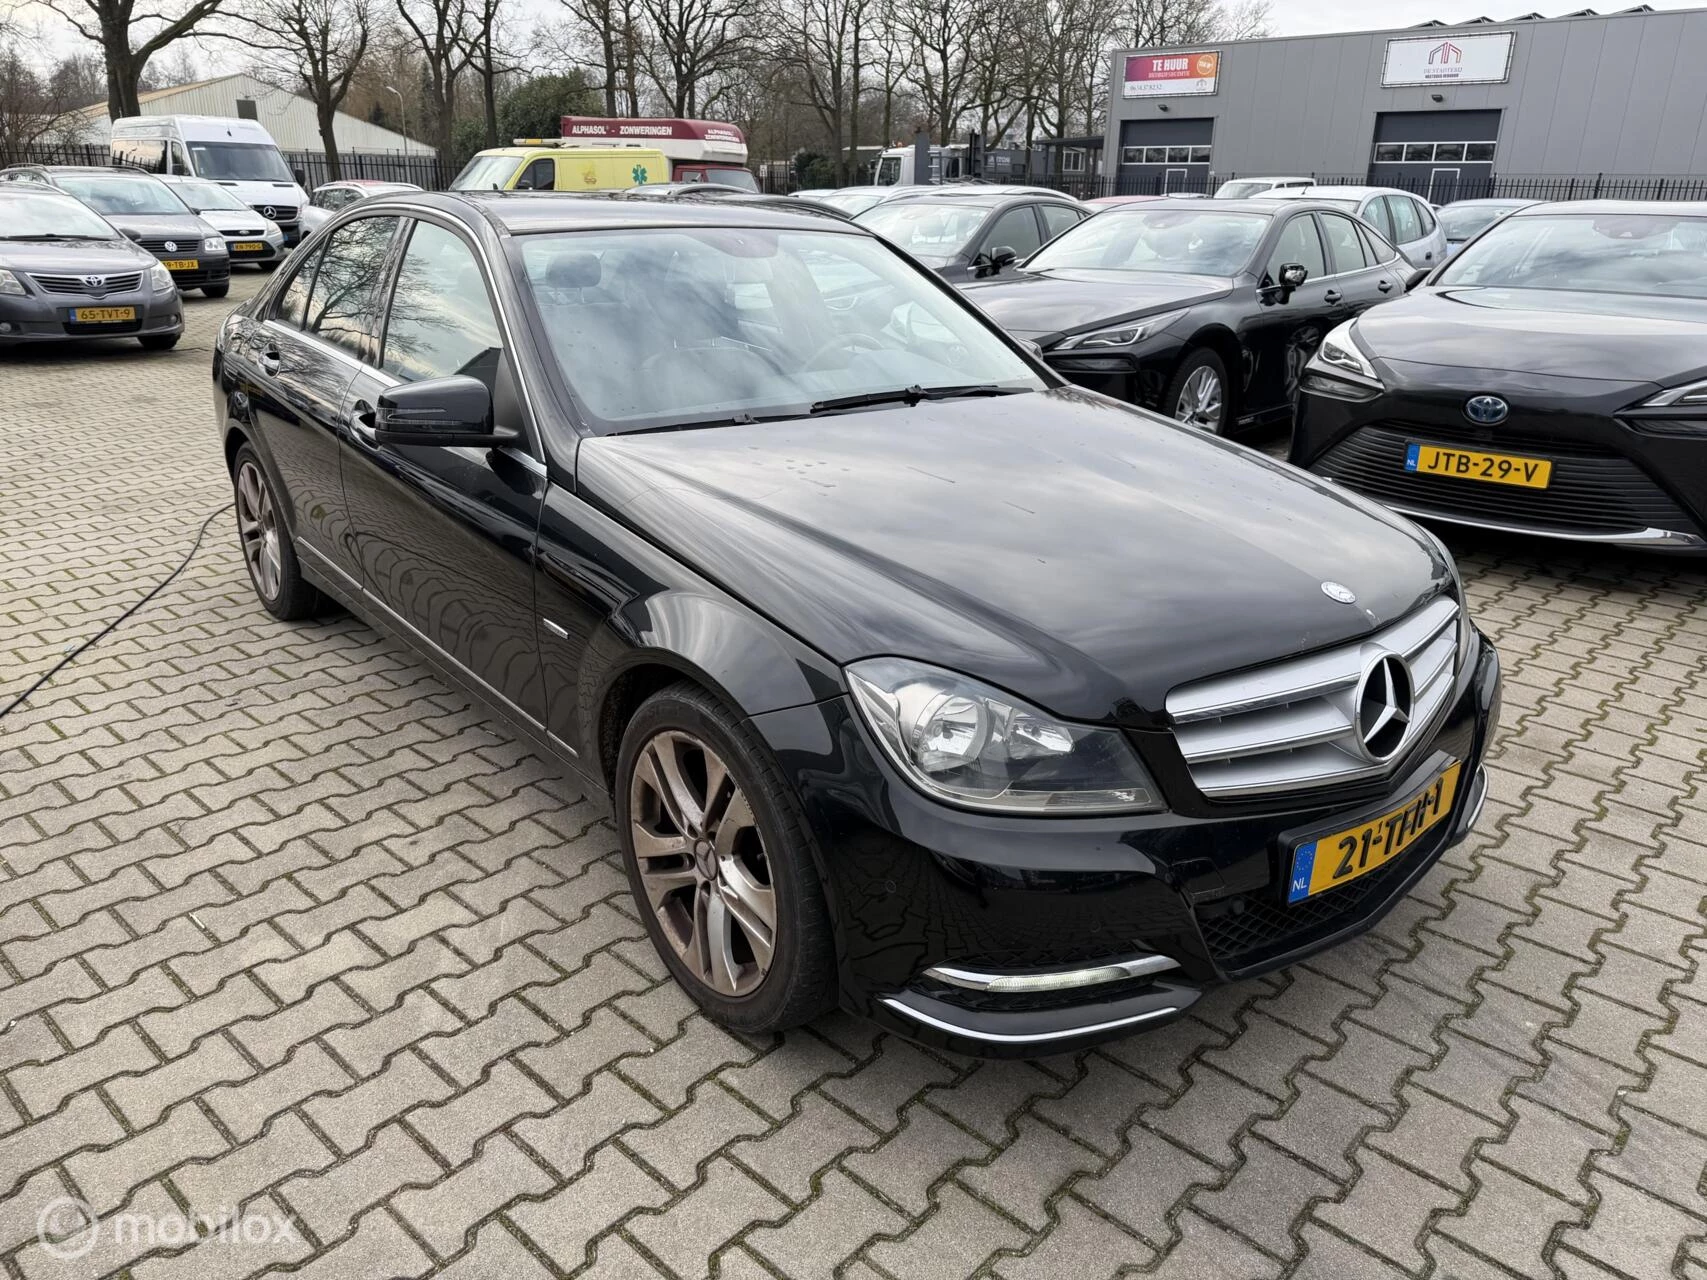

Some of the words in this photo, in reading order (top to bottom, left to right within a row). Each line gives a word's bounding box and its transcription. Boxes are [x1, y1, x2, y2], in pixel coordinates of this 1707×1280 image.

[1152, 60, 1163, 72] TE
[1164, 58, 1188, 71] HUUR
[619, 126, 672, 135] ZONWERINGEN
[80, 308, 130, 320] 65-TVT-9
[1406, 458, 1416, 467] NL
[1427, 451, 1539, 483] JTB-29-V
[1293, 877, 1307, 892] NL
